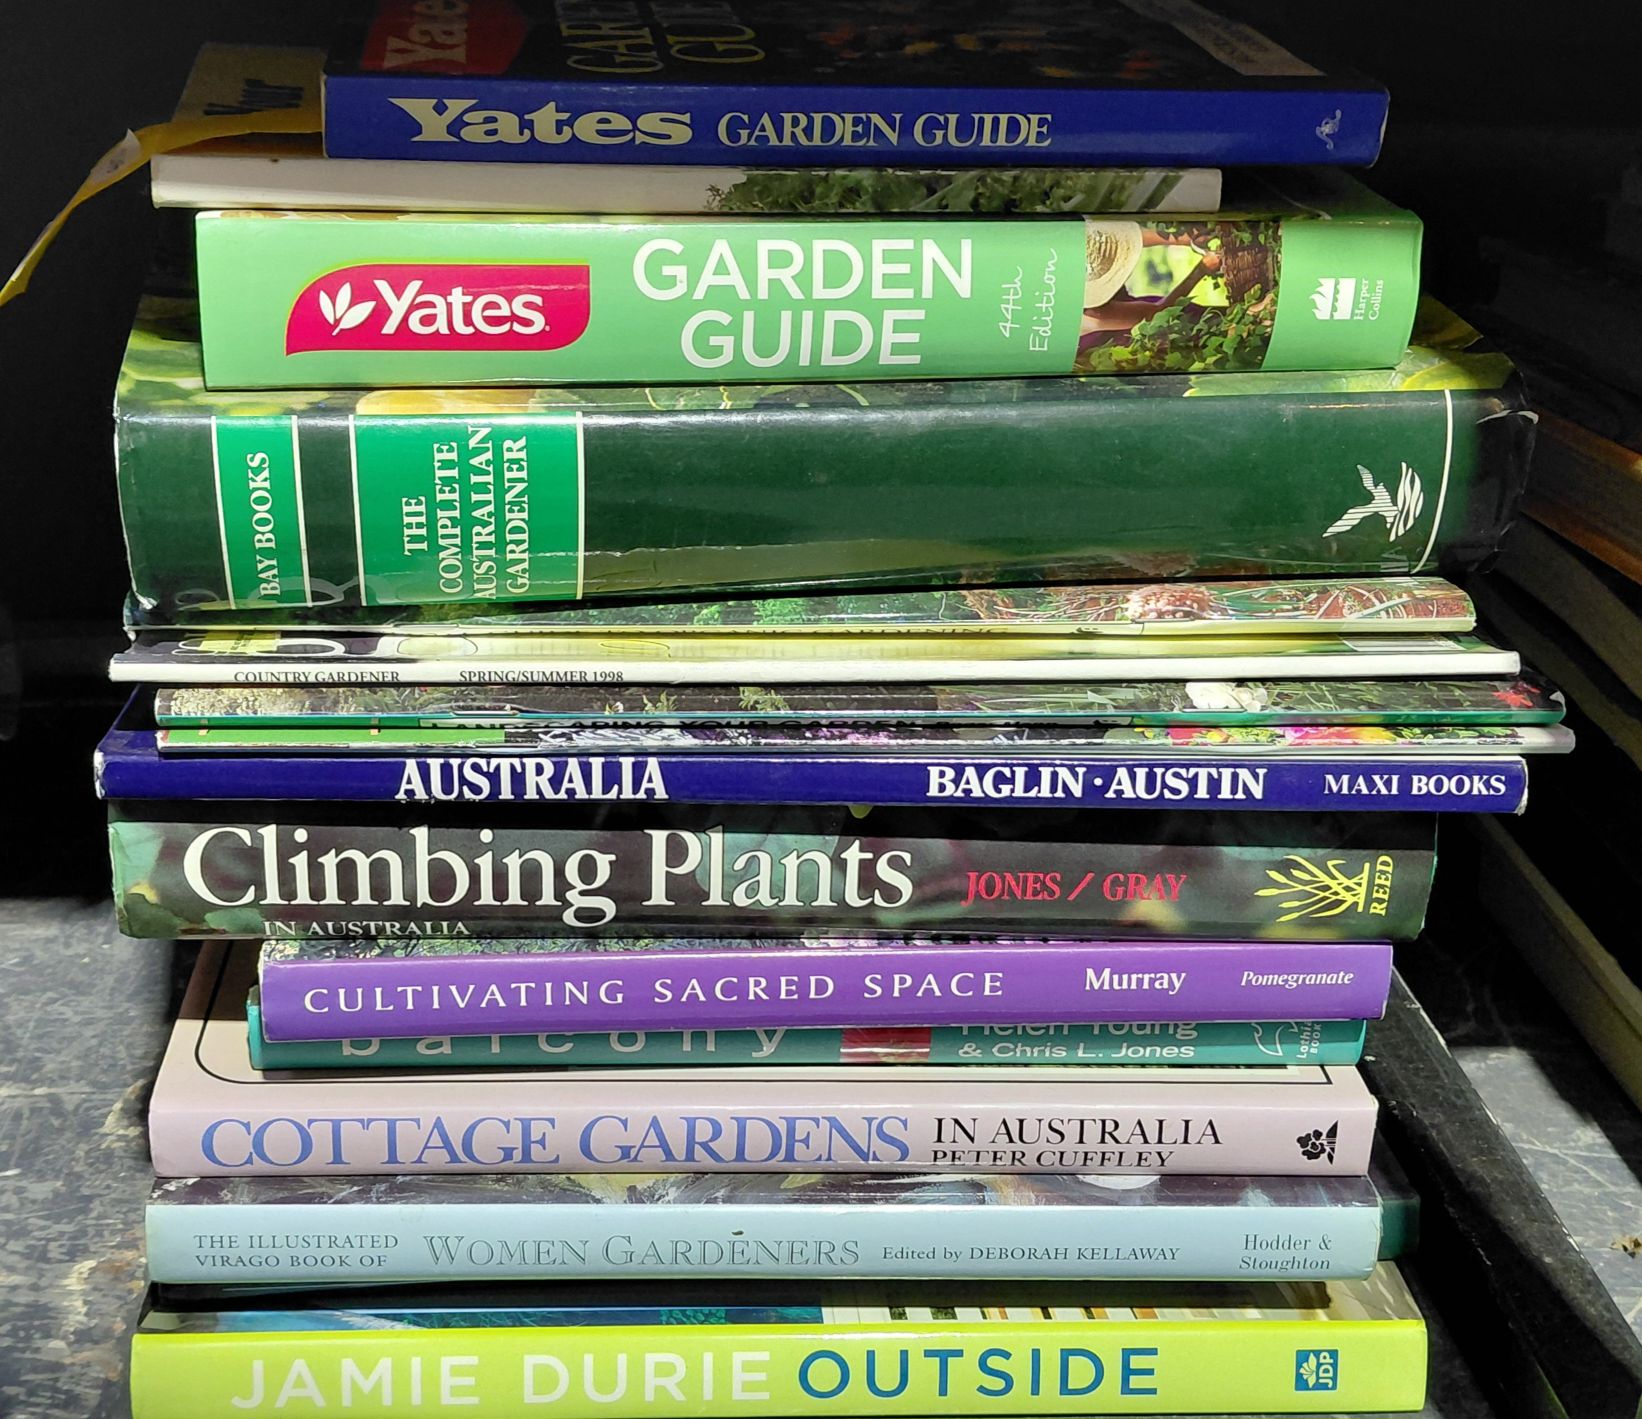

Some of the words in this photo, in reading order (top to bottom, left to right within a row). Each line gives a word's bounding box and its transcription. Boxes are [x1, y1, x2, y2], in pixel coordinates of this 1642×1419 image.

[387, 97, 693, 146] Yates
[717, 111, 903, 147] GARDEN
[913, 113, 1053, 148] GUIDE
[632, 238, 973, 301] GARDEN
[373, 279, 547, 335] Yates
[998, 265, 1023, 338] 44th
[1028, 247, 1058, 352] Edition
[1353, 277, 1371, 321] Harper
[1368, 279, 1384, 321] Collins
[680, 309, 926, 369] GUIDE
[245, 451, 277, 550] BOOKS
[433, 441, 463, 595] COMPLETE
[468, 425, 497, 600] AUSTRALIAN
[502, 435, 530, 595] GARDENER
[401, 495, 428, 556] THE
[253, 556, 282, 597] BAY
[234, 671, 312, 683] COUNTRY
[315, 671, 400, 683] GARDENER
[459, 670, 588, 683] SPRING/SUMMER
[593, 670, 624, 683] 1998
[396, 756, 670, 802] AUSTRALIA
[926, 765, 1087, 799] BAGLIN
[1104, 766, 1267, 800] AUSTIN
[1323, 773, 1400, 795] MAXI
[1410, 774, 1507, 796] BOOKS
[183, 824, 617, 928] Climbing
[641, 825, 914, 908] Plants
[960, 870, 1062, 908] JONES
[1102, 872, 1188, 902] GRAY
[1369, 855, 1394, 917] REED
[262, 920, 297, 936] IN
[307, 920, 472, 936] AUSTRALIA
[304, 979, 625, 1013] CULTIVATING
[654, 974, 835, 1003] SACRED
[863, 971, 1005, 999] SPACE
[1084, 967, 1187, 995] Murray
[1240, 970, 1355, 990] Pomegranate
[958, 1042, 983, 1058] &
[992, 1042, 1068, 1058] Chris
[1077, 1042, 1103, 1058] L.
[1111, 1042, 1196, 1058] Jones
[201, 1115, 560, 1168] COTTAGE
[578, 1114, 910, 1165] GARDENS
[934, 1117, 979, 1144] IN
[990, 1117, 1224, 1146] AUSTRALIA
[931, 1149, 1027, 1167] PETER
[1036, 1150, 1175, 1168] CUFFLEY
[193, 1234, 240, 1249] THE
[249, 1234, 399, 1249] ILLUSTRATED
[195, 1254, 281, 1267] VIRAGO
[289, 1254, 353, 1267] BOOK
[359, 1254, 388, 1267] OF
[423, 1234, 590, 1266] WOMEN
[602, 1234, 860, 1266] GARDENERS
[882, 1246, 936, 1260] Edited
[943, 1246, 963, 1262] by
[969, 1246, 1070, 1260] DEBORAH
[1077, 1247, 1181, 1261] KELLAWAY
[1243, 1233, 1312, 1251] Hodder
[1318, 1233, 1333, 1251] &
[1239, 1255, 1331, 1272] Stoughton
[231, 1355, 481, 1408] JAMIE
[523, 1351, 771, 1405] DURIE
[797, 1346, 1160, 1399] OUTSIDE
[1318, 1351, 1335, 1389] JDP
